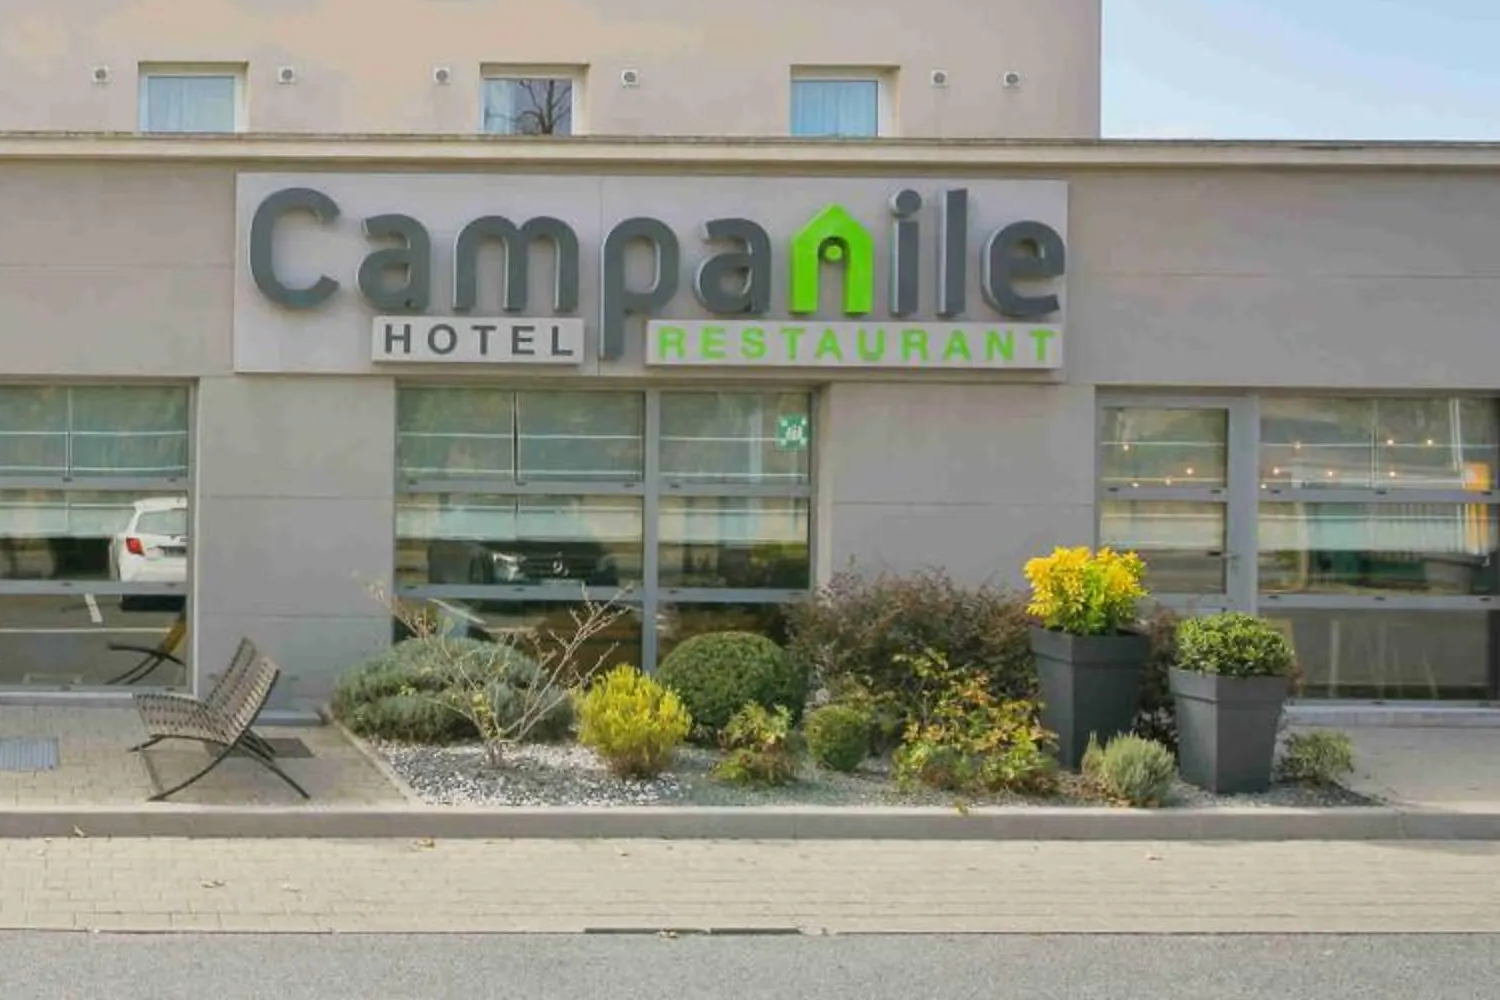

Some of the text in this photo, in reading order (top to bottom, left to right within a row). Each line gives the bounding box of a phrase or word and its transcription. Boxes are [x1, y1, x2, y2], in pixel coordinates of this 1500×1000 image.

[250, 187, 1066, 360] Campanile
[383, 324, 573, 357] HOTEL
[659, 326, 1055, 361] RESTAURANT
